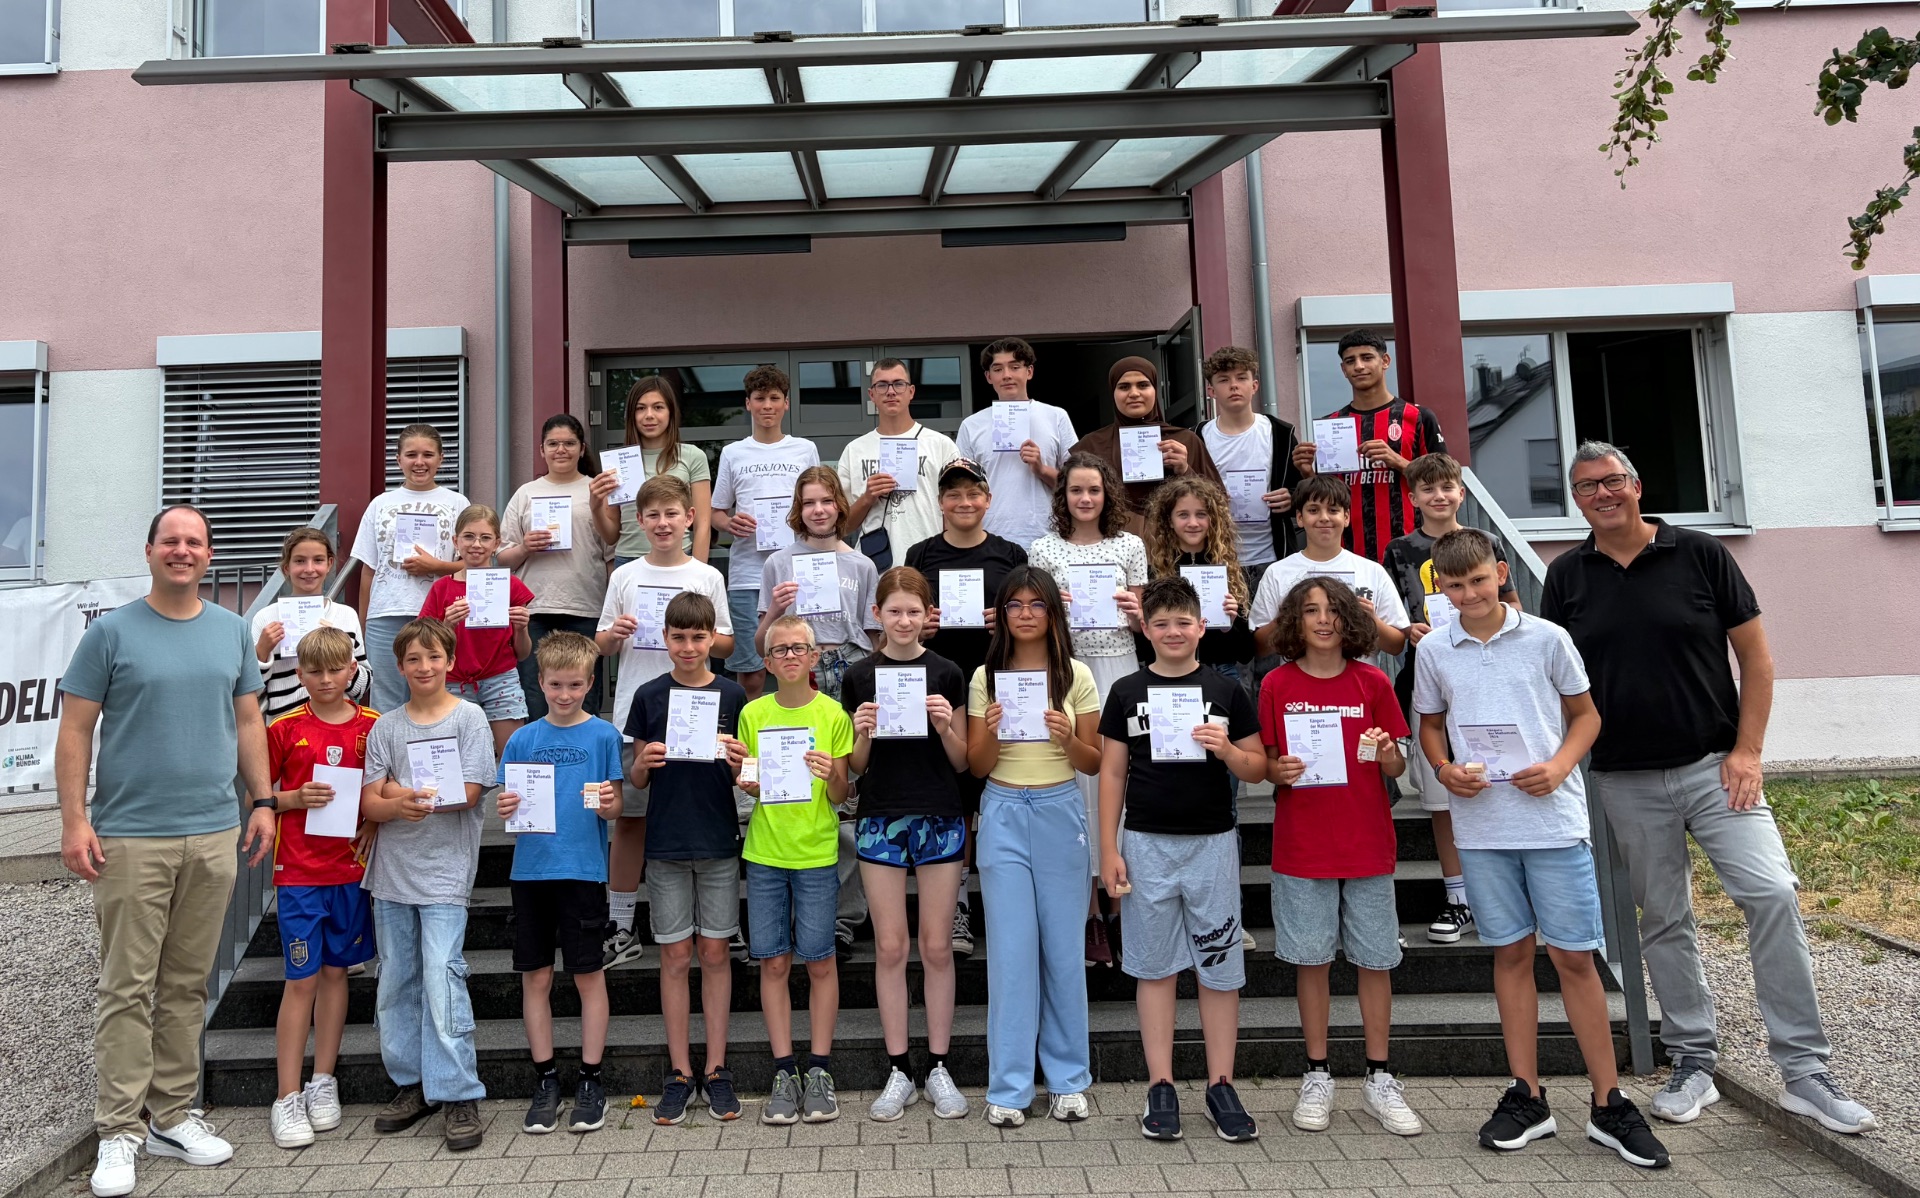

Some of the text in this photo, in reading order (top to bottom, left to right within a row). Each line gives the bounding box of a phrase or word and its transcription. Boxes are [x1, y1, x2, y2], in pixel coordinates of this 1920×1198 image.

[739, 463, 801, 476] JACK&JONES
[861, 458, 881, 482] NE
[1344, 470, 1395, 486] FLY BETTER
[76, 601, 100, 610] Wir sind
[15, 753, 35, 761] KLIMA
[15, 758, 41, 768] BÜNDNIS
[1191, 914, 1235, 948] Reebok
